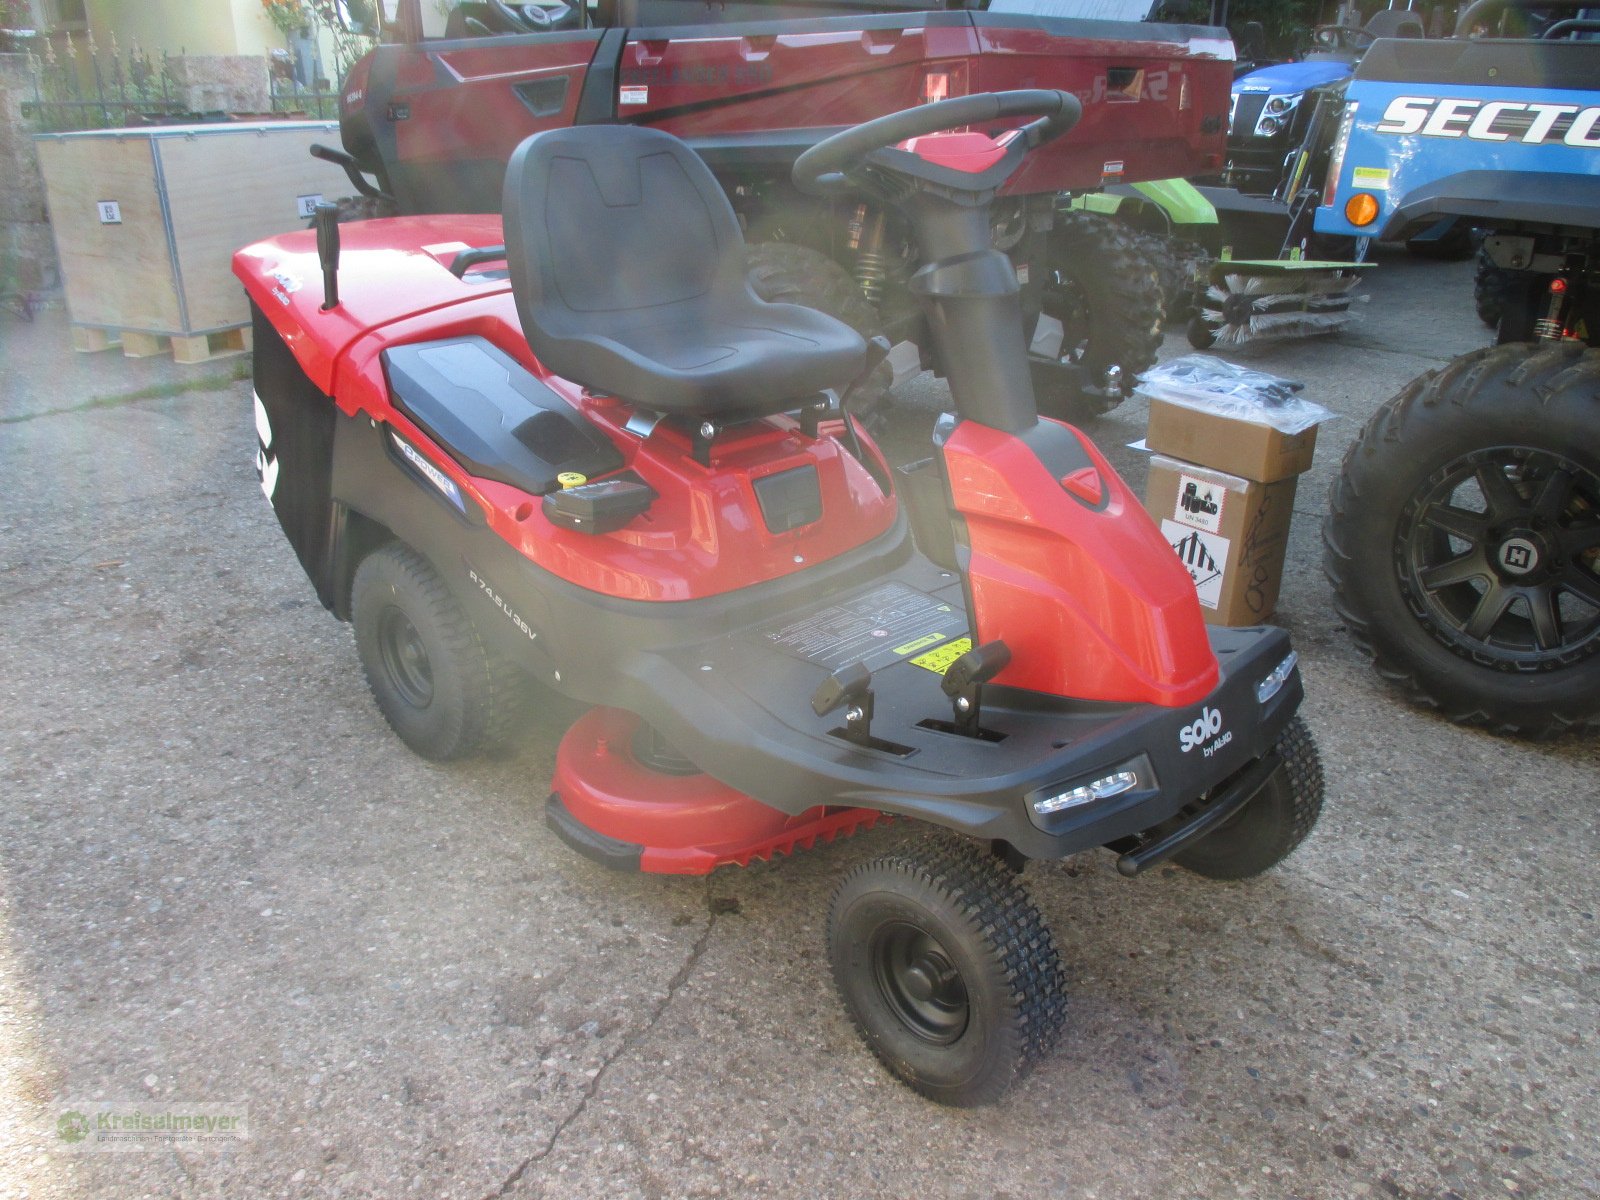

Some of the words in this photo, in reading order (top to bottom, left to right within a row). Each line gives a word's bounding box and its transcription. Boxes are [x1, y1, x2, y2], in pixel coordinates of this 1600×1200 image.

[414, 456, 454, 493] POWER
[513, 613, 537, 640] 36V
[1180, 706, 1221, 753] solo
[1203, 745, 1214, 757] by
